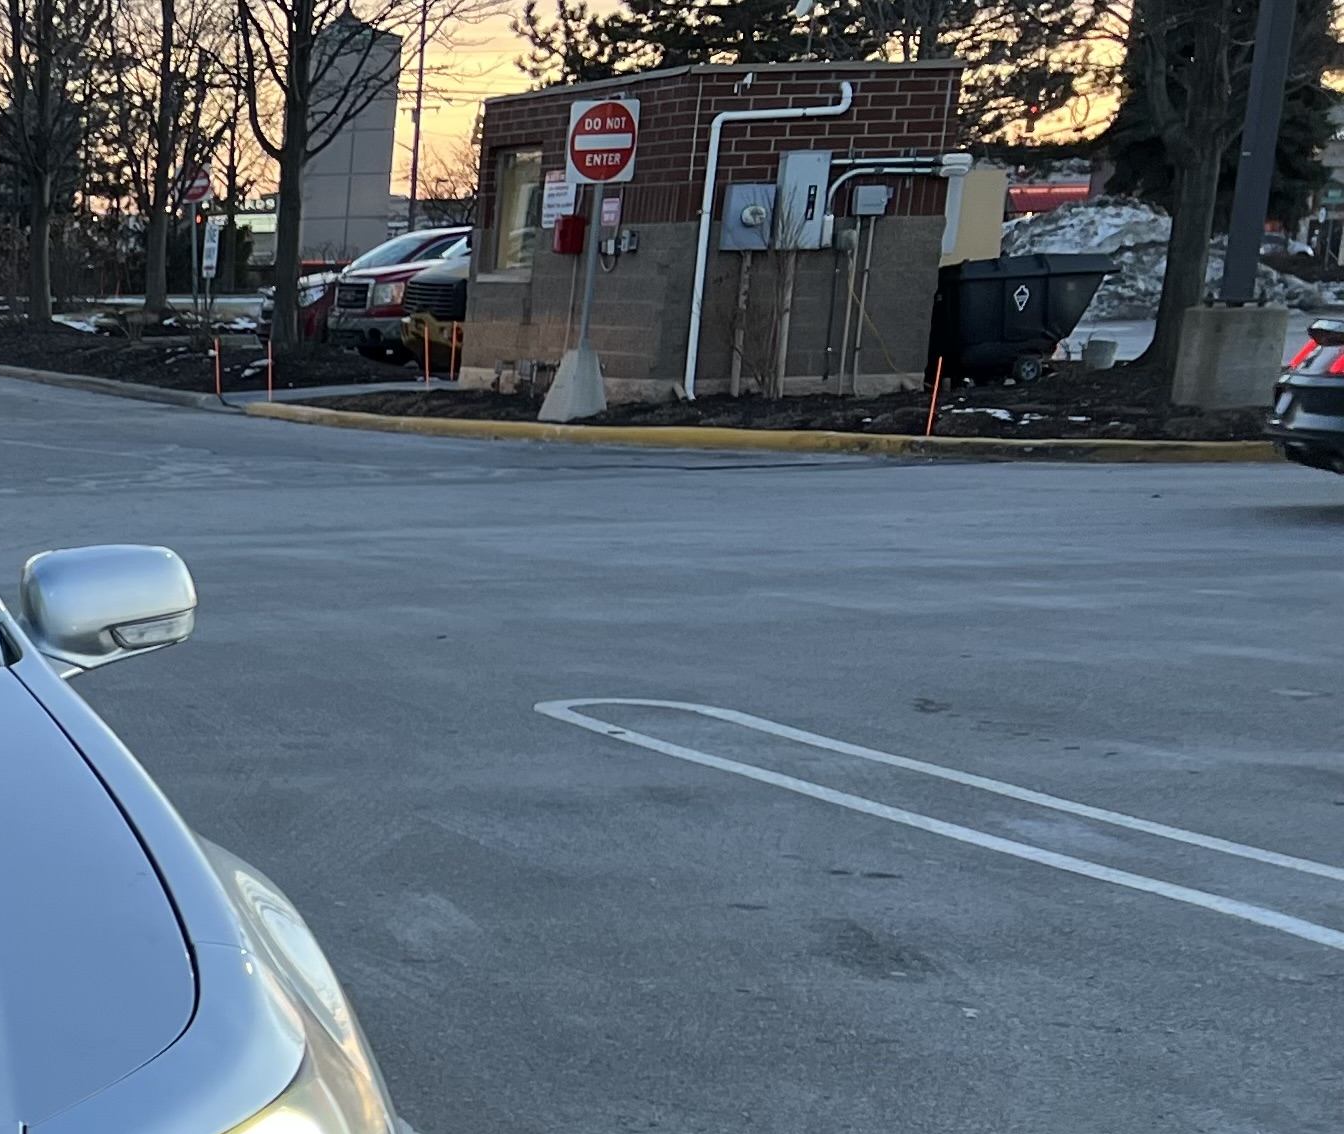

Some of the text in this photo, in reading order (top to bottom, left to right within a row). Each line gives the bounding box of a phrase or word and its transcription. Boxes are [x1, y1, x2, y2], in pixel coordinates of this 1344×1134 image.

[584, 117, 627, 130] DO NOT
[585, 153, 621, 167] ENTER
